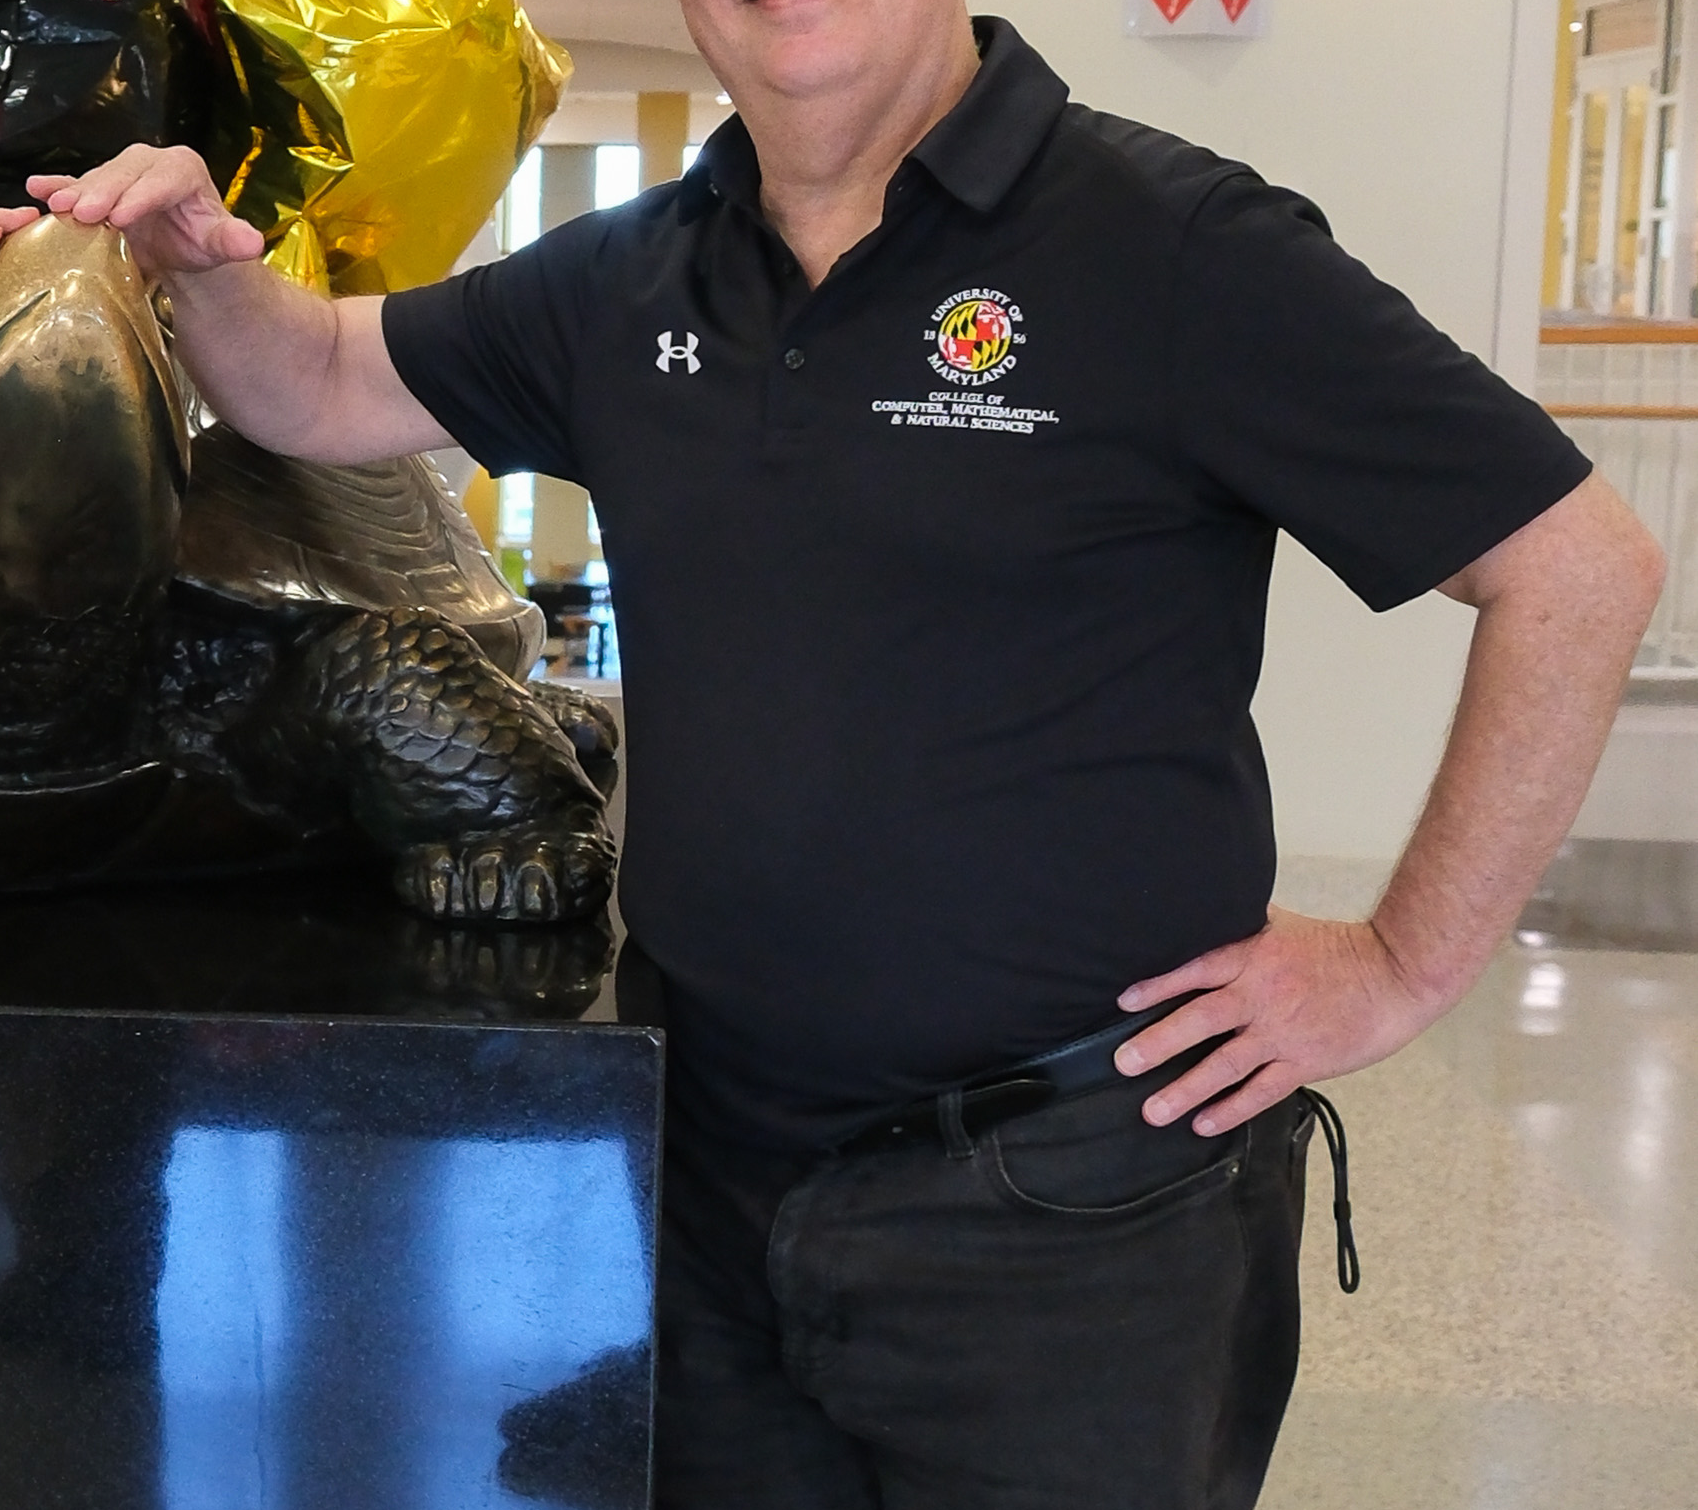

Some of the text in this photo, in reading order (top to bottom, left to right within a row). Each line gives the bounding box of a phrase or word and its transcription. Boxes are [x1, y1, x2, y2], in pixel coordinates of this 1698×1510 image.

[930, 287, 1025, 323] UNIVERSITY OF
[926, 352, 1017, 386] MARYLAND
[928, 392, 1005, 405] COLLEGE OF
[890, 413, 1035, 435] & NATURAL SCIENCES
